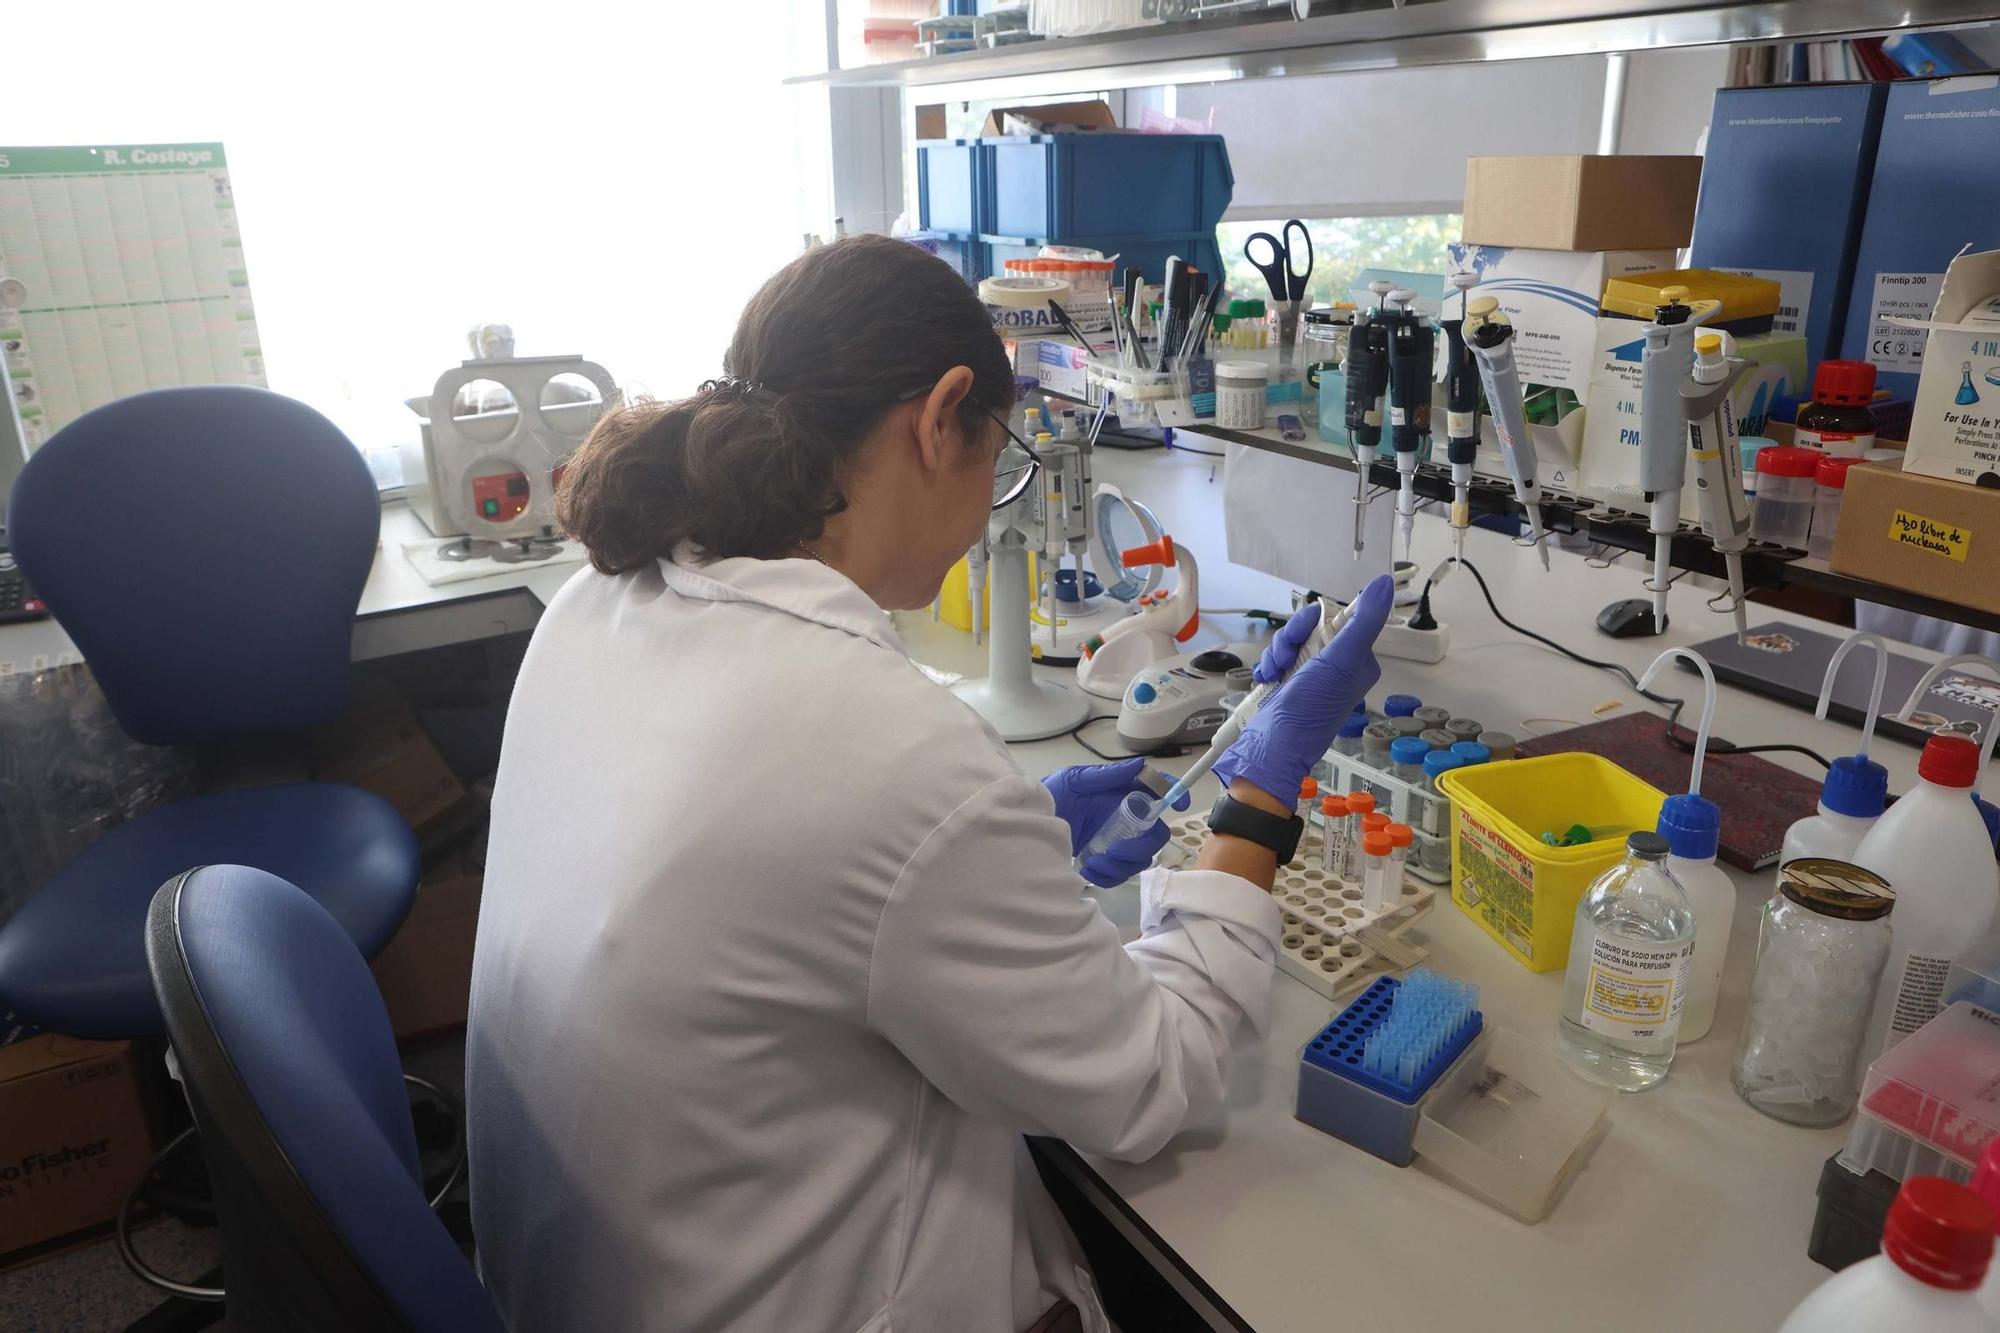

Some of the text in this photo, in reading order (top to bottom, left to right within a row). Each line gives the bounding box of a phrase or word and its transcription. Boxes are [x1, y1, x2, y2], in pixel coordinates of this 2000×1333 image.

[103, 148, 213, 166] R. Costoya
[1881, 276, 1927, 286] Finntip 300
[1971, 340, 1979, 356] 4
[1616, 400, 1622, 413] 4
[1944, 411, 1959, 423] For
[1961, 414, 1979, 426] Use
[1981, 416, 1991, 428] In
[1957, 426, 1977, 438] Simply
[1978, 430, 1993, 440] Press
[1954, 435, 1990, 449] Perforations
[1973, 451, 1996, 462] PINCH
[1955, 467, 1976, 477] INSERT
[1920, 520, 1946, 541] libre
[1949, 528, 1963, 544] de
[1595, 939, 1621, 955] CLORURO
[1621, 949, 1630, 957] DE
[1630, 951, 1650, 960] SODIO
[1593, 948, 1672, 970] SOLUCIÓN PARA PERFUSIÓN
